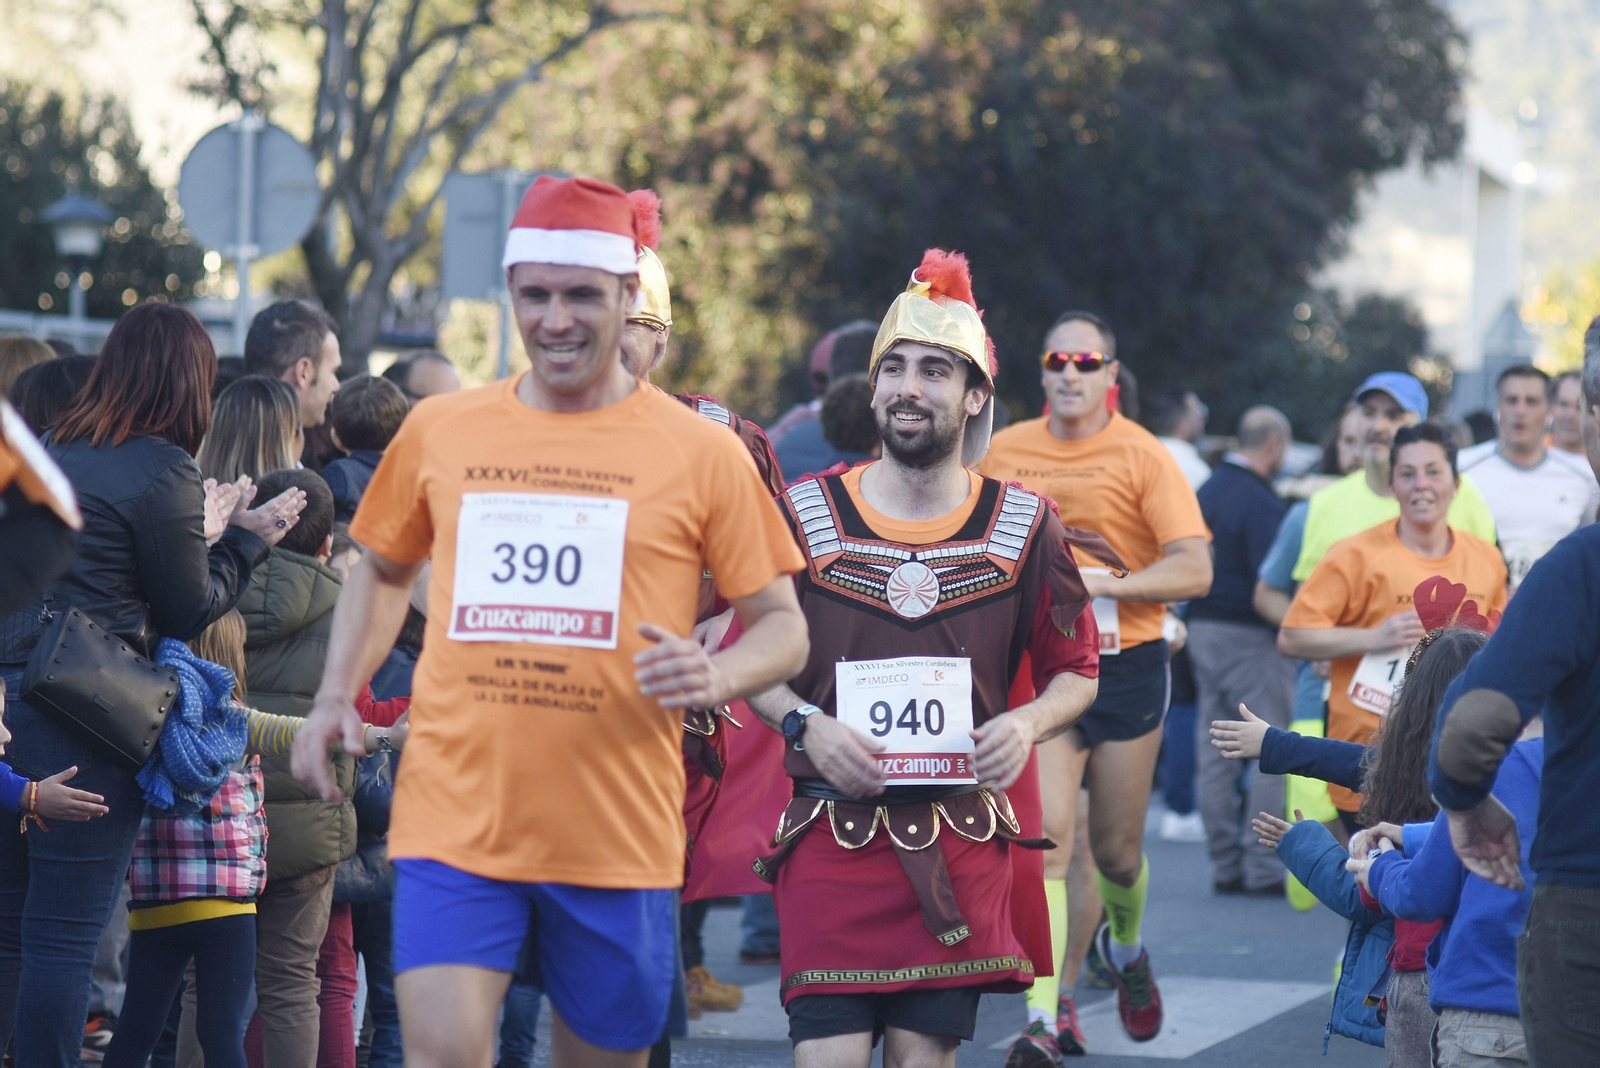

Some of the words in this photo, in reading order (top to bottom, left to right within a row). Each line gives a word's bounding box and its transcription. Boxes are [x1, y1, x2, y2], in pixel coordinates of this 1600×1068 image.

[464, 466, 529, 484] XXXVI
[491, 542, 582, 587] 390
[464, 605, 585, 636] Cruzcampo
[854, 663, 880, 671] XXXVI
[896, 660, 924, 668] Silvestre
[925, 660, 957, 668] Cordobesa
[868, 673, 909, 685] IMDECO
[869, 698, 945, 738] 940
[878, 758, 952, 778] zcampo
[956, 758, 966, 774] SIN
